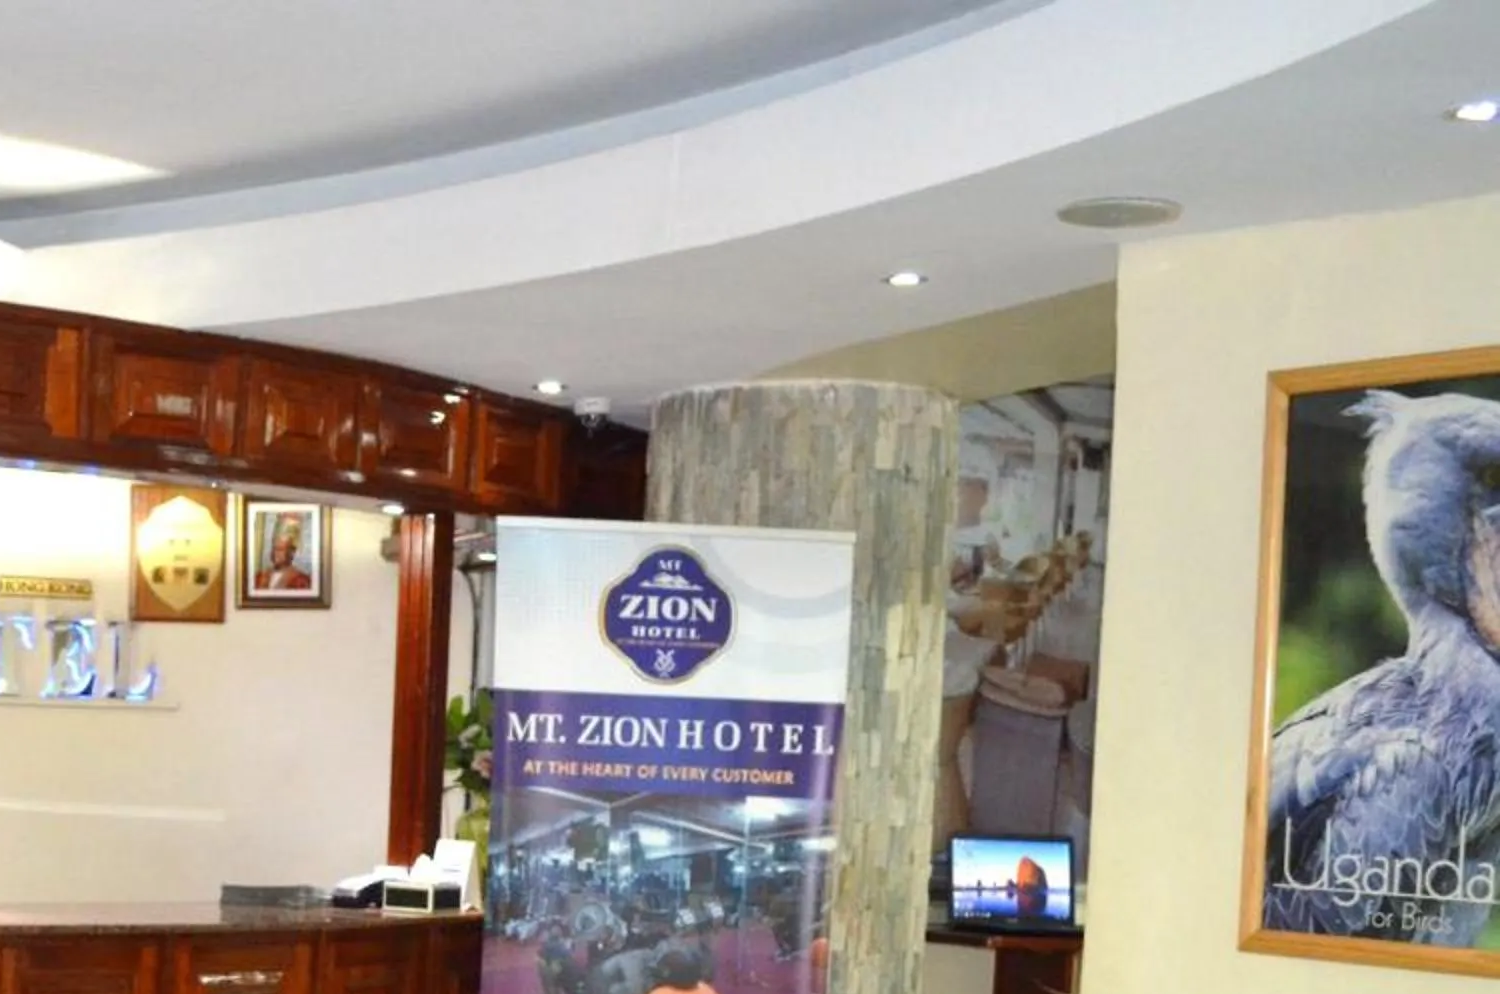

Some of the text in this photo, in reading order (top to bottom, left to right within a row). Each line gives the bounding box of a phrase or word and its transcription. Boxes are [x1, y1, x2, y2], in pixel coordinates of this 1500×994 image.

[0, 580, 44, 595] HONG
[618, 594, 718, 622] ZION
[631, 625, 700, 640] HOTEL
[507, 711, 835, 755] MT. ZION HOTEL
[523, 759, 796, 785] AT THE HEART OF EVERY CUSTOMER
[1283, 815, 1496, 906] Uganda
[1365, 902, 1453, 932] for Birds
